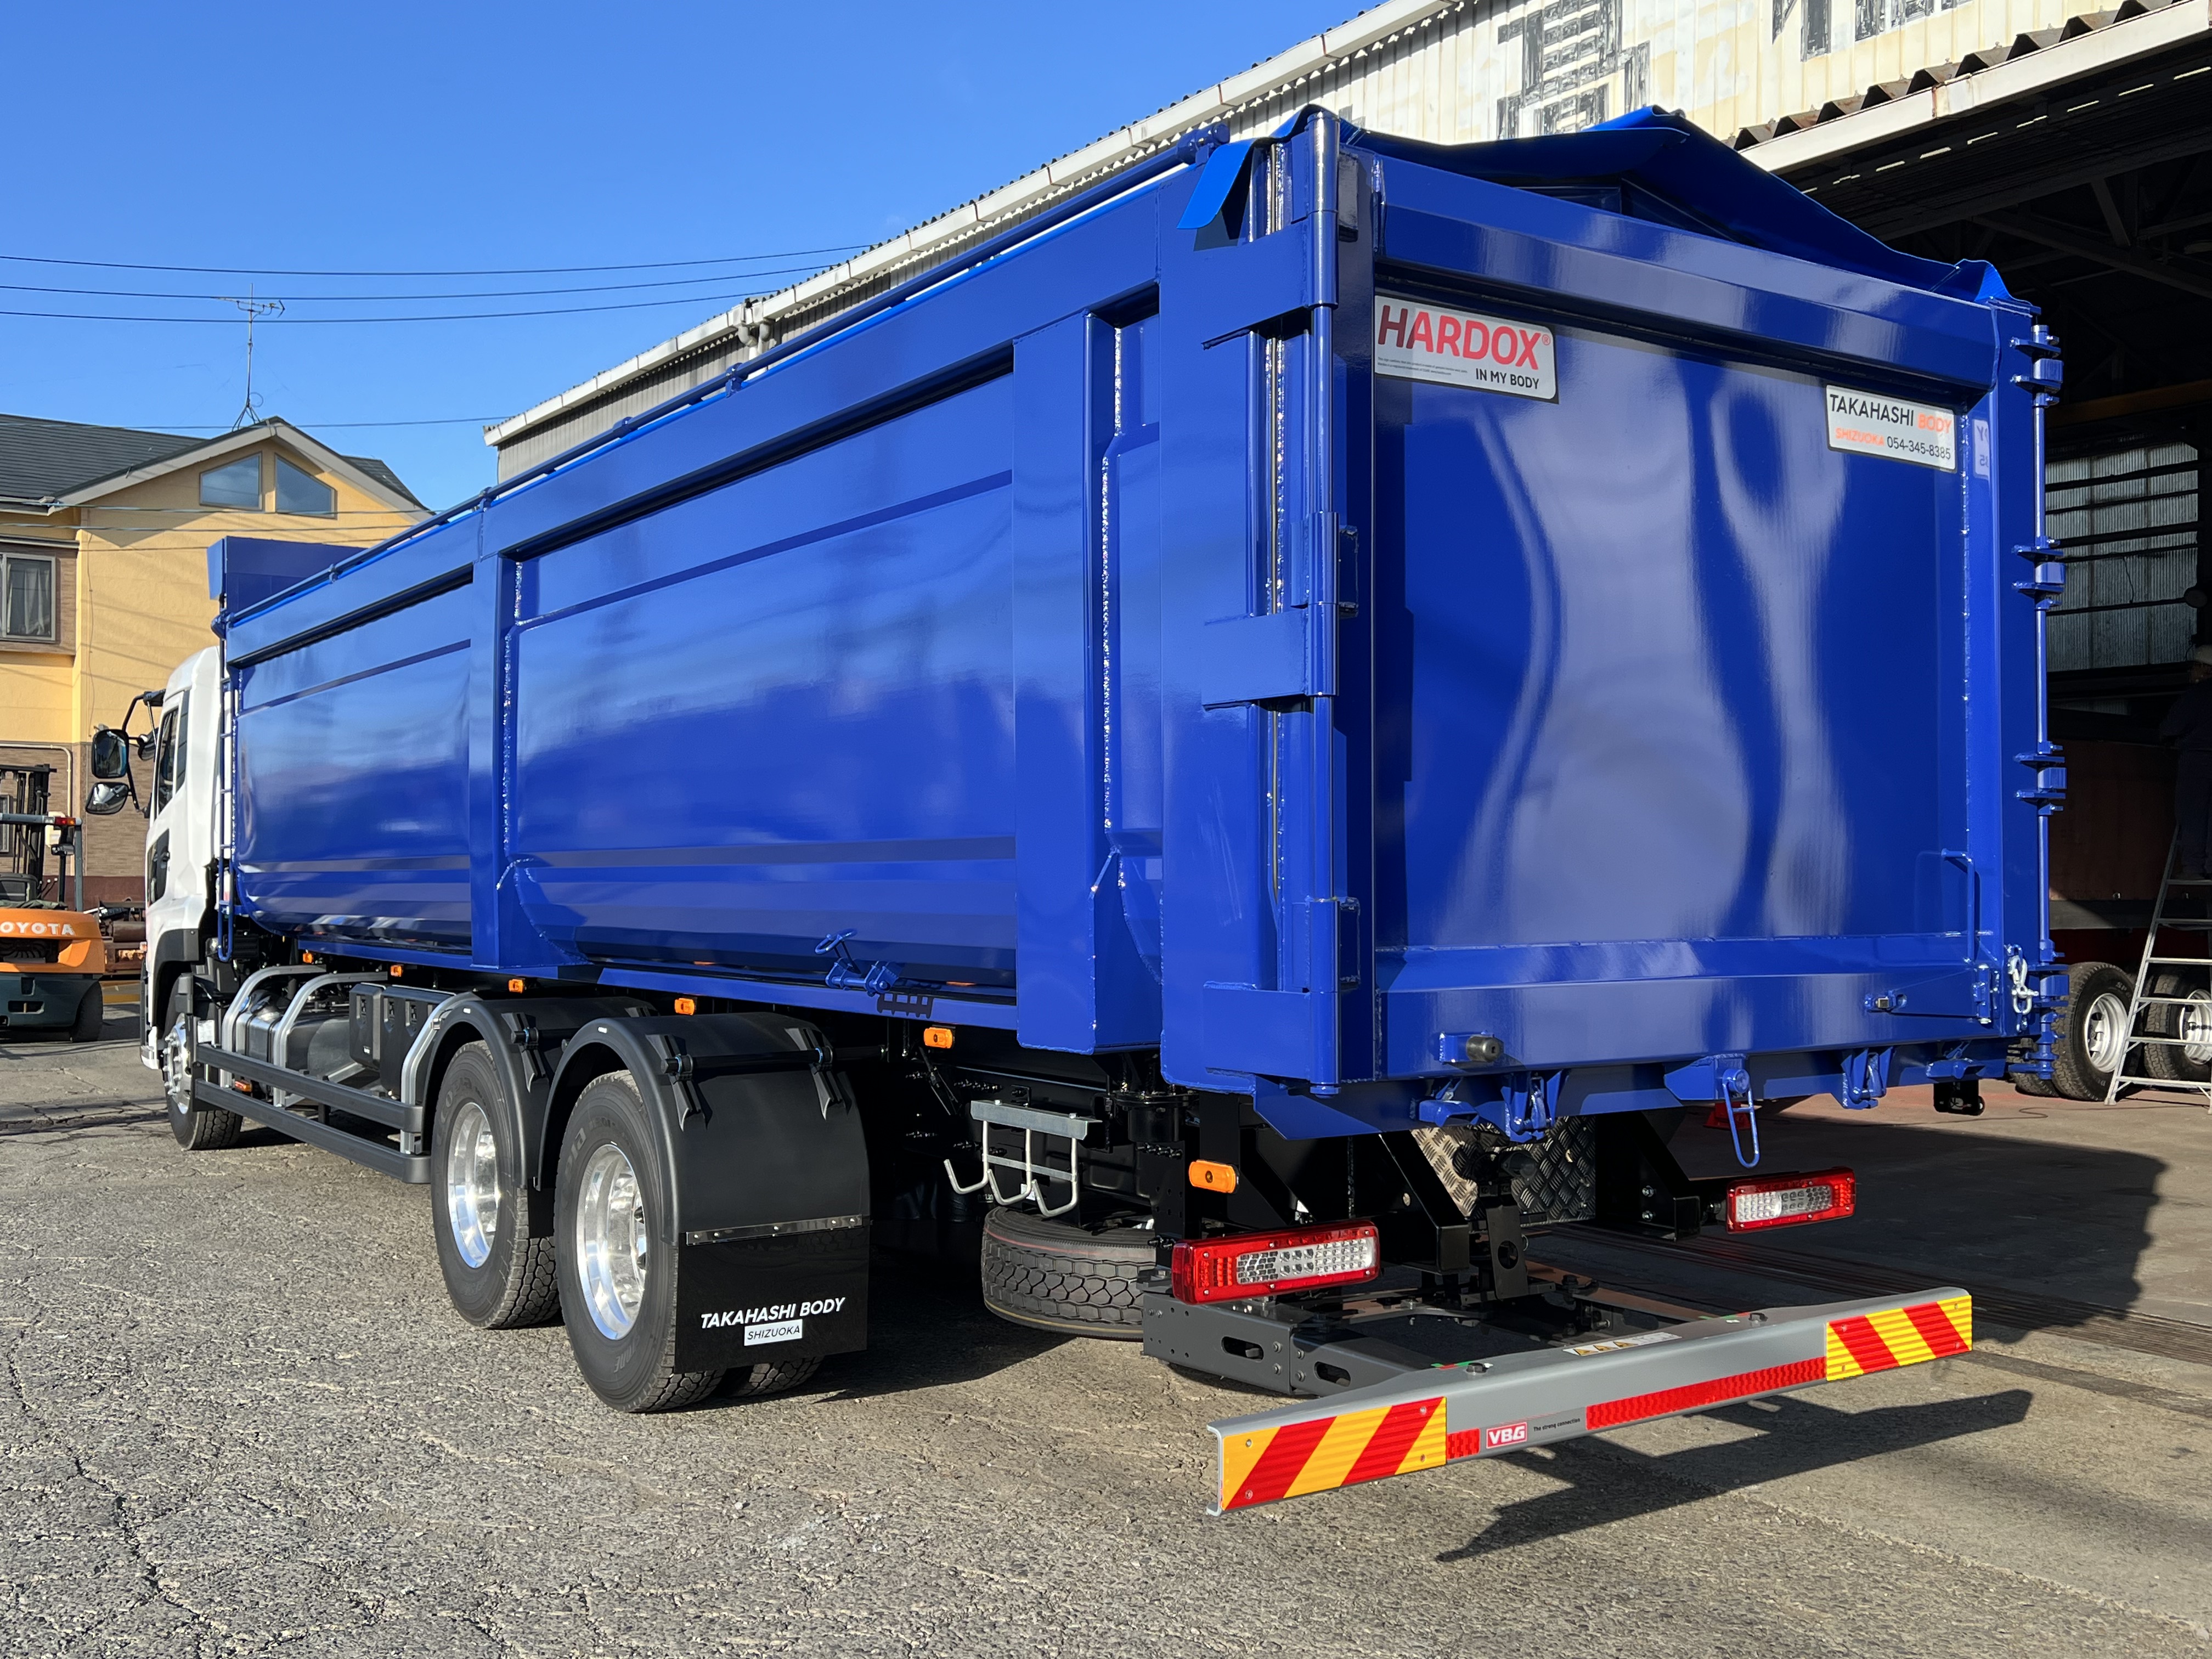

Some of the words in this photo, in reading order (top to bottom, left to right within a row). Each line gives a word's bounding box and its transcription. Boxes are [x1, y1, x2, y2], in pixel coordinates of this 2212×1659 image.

[1476, 368, 1487, 382] IN
[1491, 370, 1506, 384] MY
[1510, 374, 1539, 390] BODY
[1830, 394, 1914, 426] TAKAHASHI
[1917, 414, 1952, 433] BODY
[1835, 427, 1884, 446] SHIZUOKA
[1887, 436, 1951, 460] 054-345-8385
[0, 921, 76, 936] OYOTA
[701, 1303, 796, 1329] TAKAHASHI
[800, 1297, 845, 1317] BODY
[747, 1325, 800, 1340] SHIZUOKA
[1488, 1426, 1525, 1444] VBG
